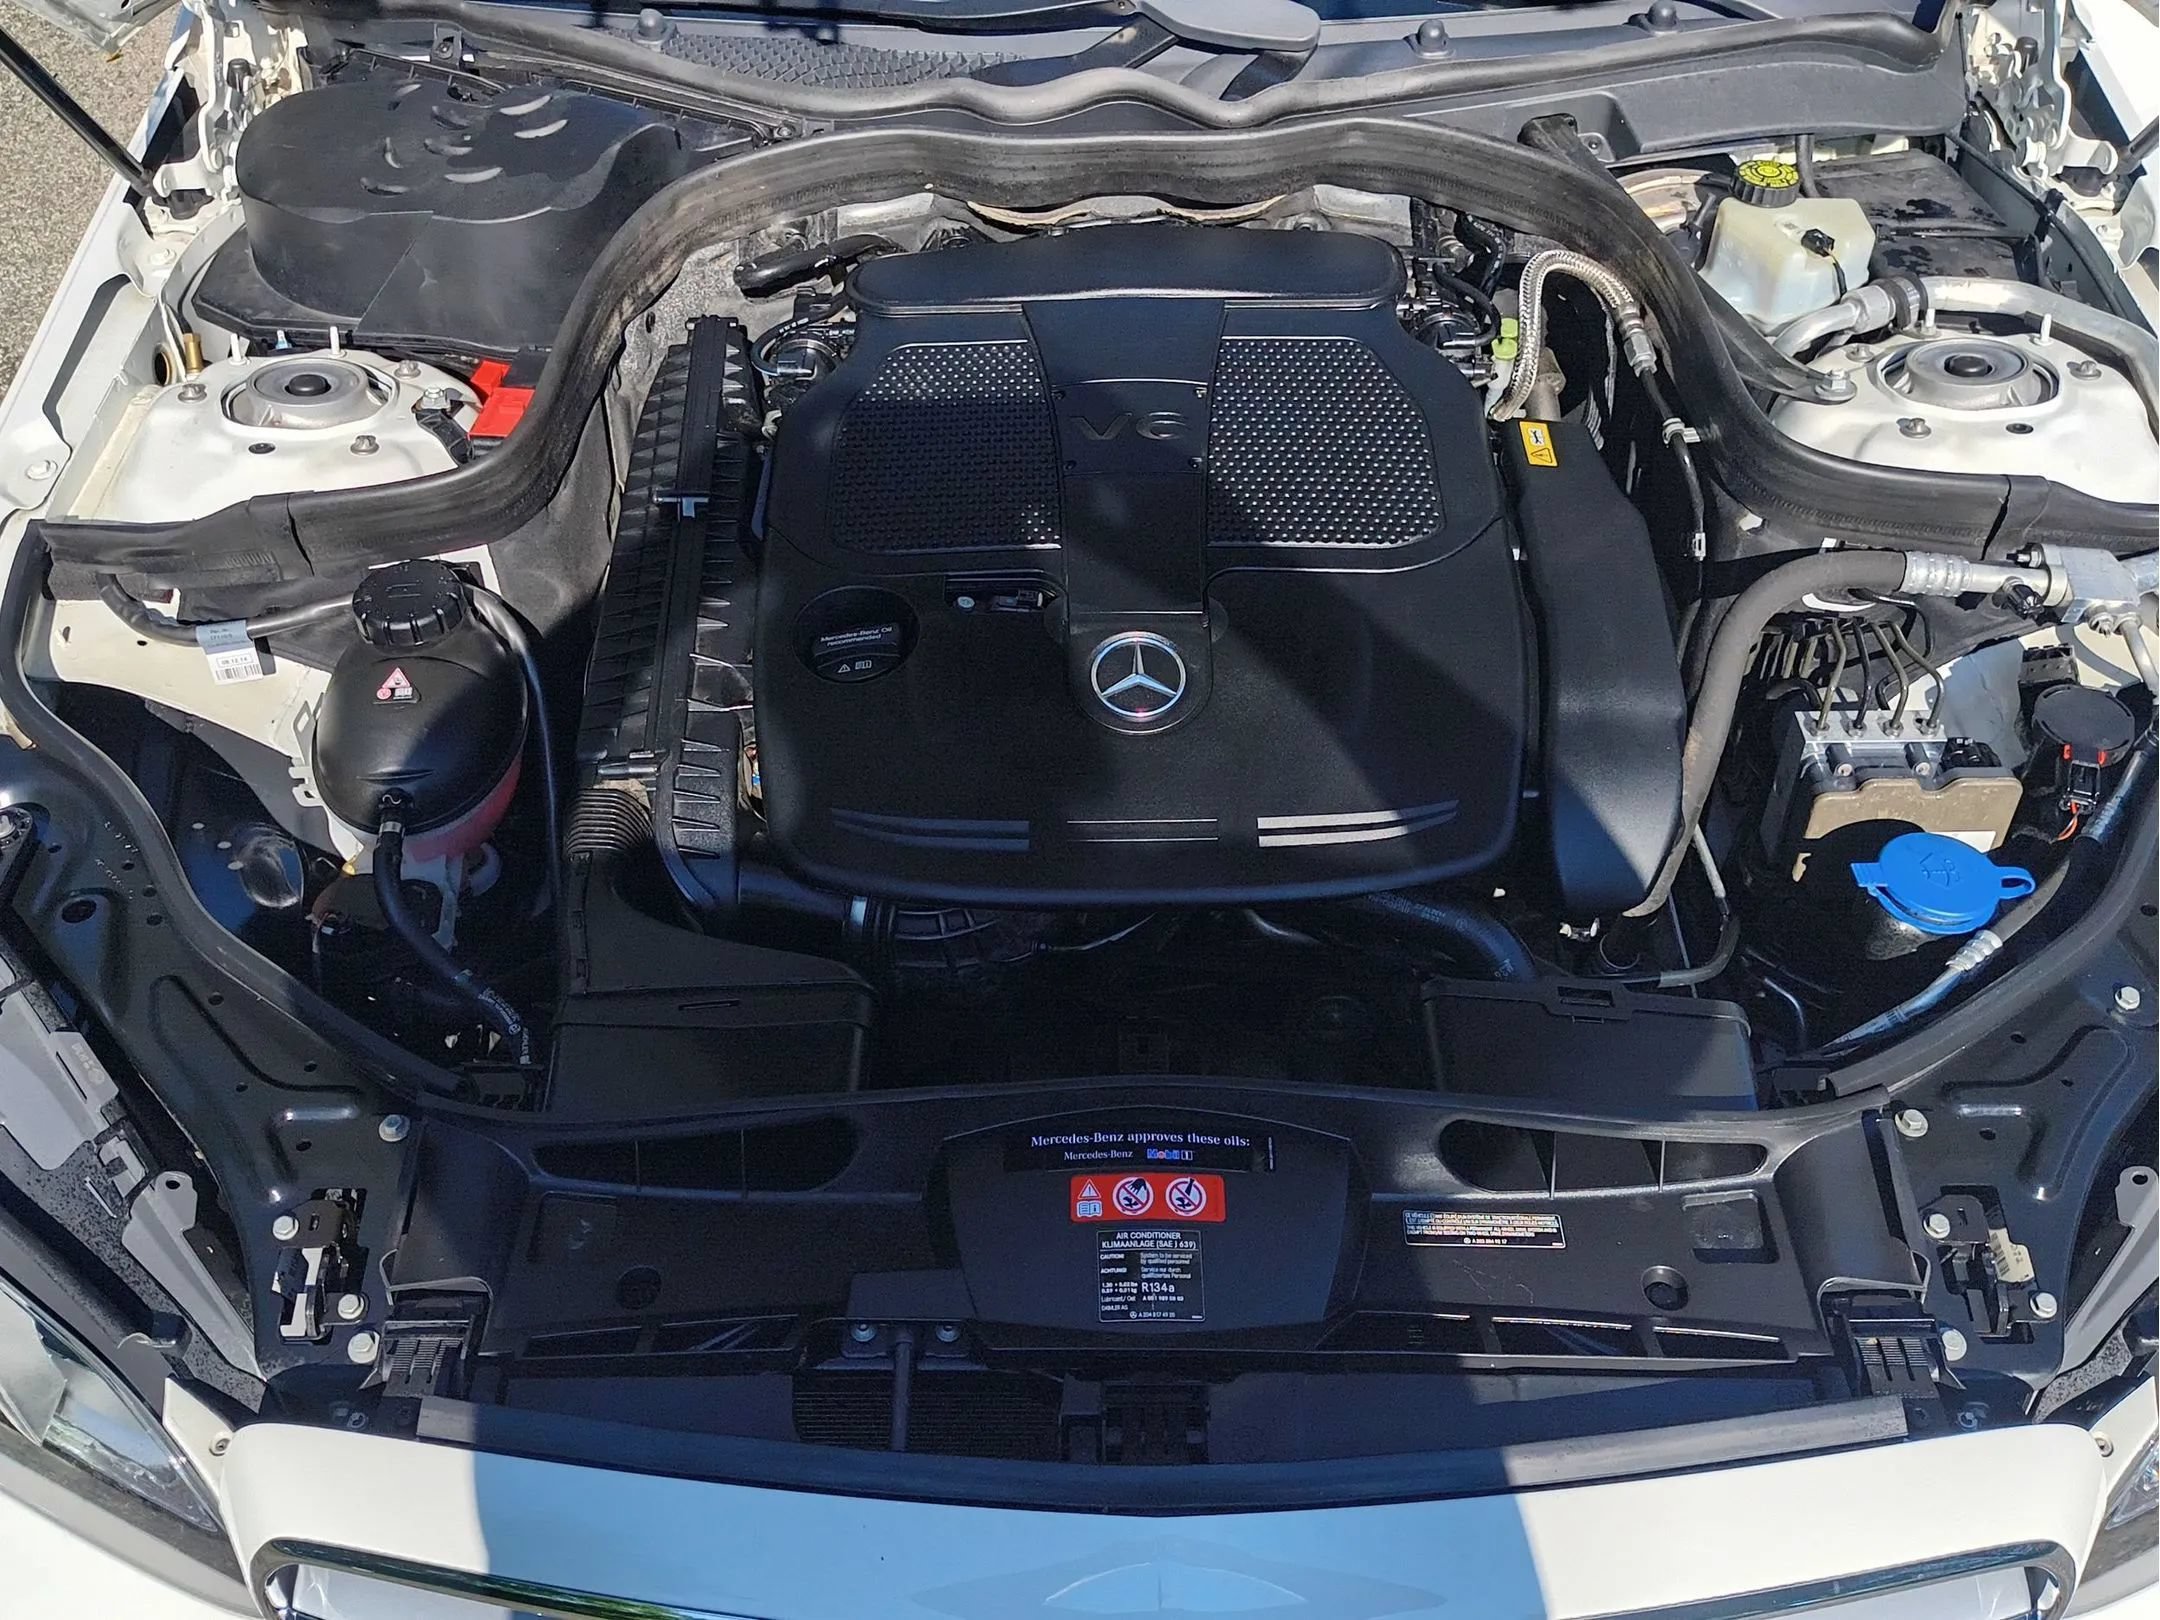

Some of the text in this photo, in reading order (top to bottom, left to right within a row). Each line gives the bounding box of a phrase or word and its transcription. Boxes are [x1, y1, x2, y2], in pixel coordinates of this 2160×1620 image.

[1070, 411, 1190, 440] V6
[821, 629, 880, 642] Mercedes-Benz
[827, 634, 881, 646] recommended
[1031, 1132, 1250, 1147] Mercedes-Benz approves these oils:
[1064, 1149, 1133, 1160] Mercedes-Benz
[1147, 1149, 1180, 1160] Mobil
[1102, 1240, 1155, 1248] KLIMAANLAGE
[1156, 1240, 1173, 1249] (SAE
[1179, 1241, 1196, 1249] 639)
[1141, 1282, 1175, 1293] R134a
